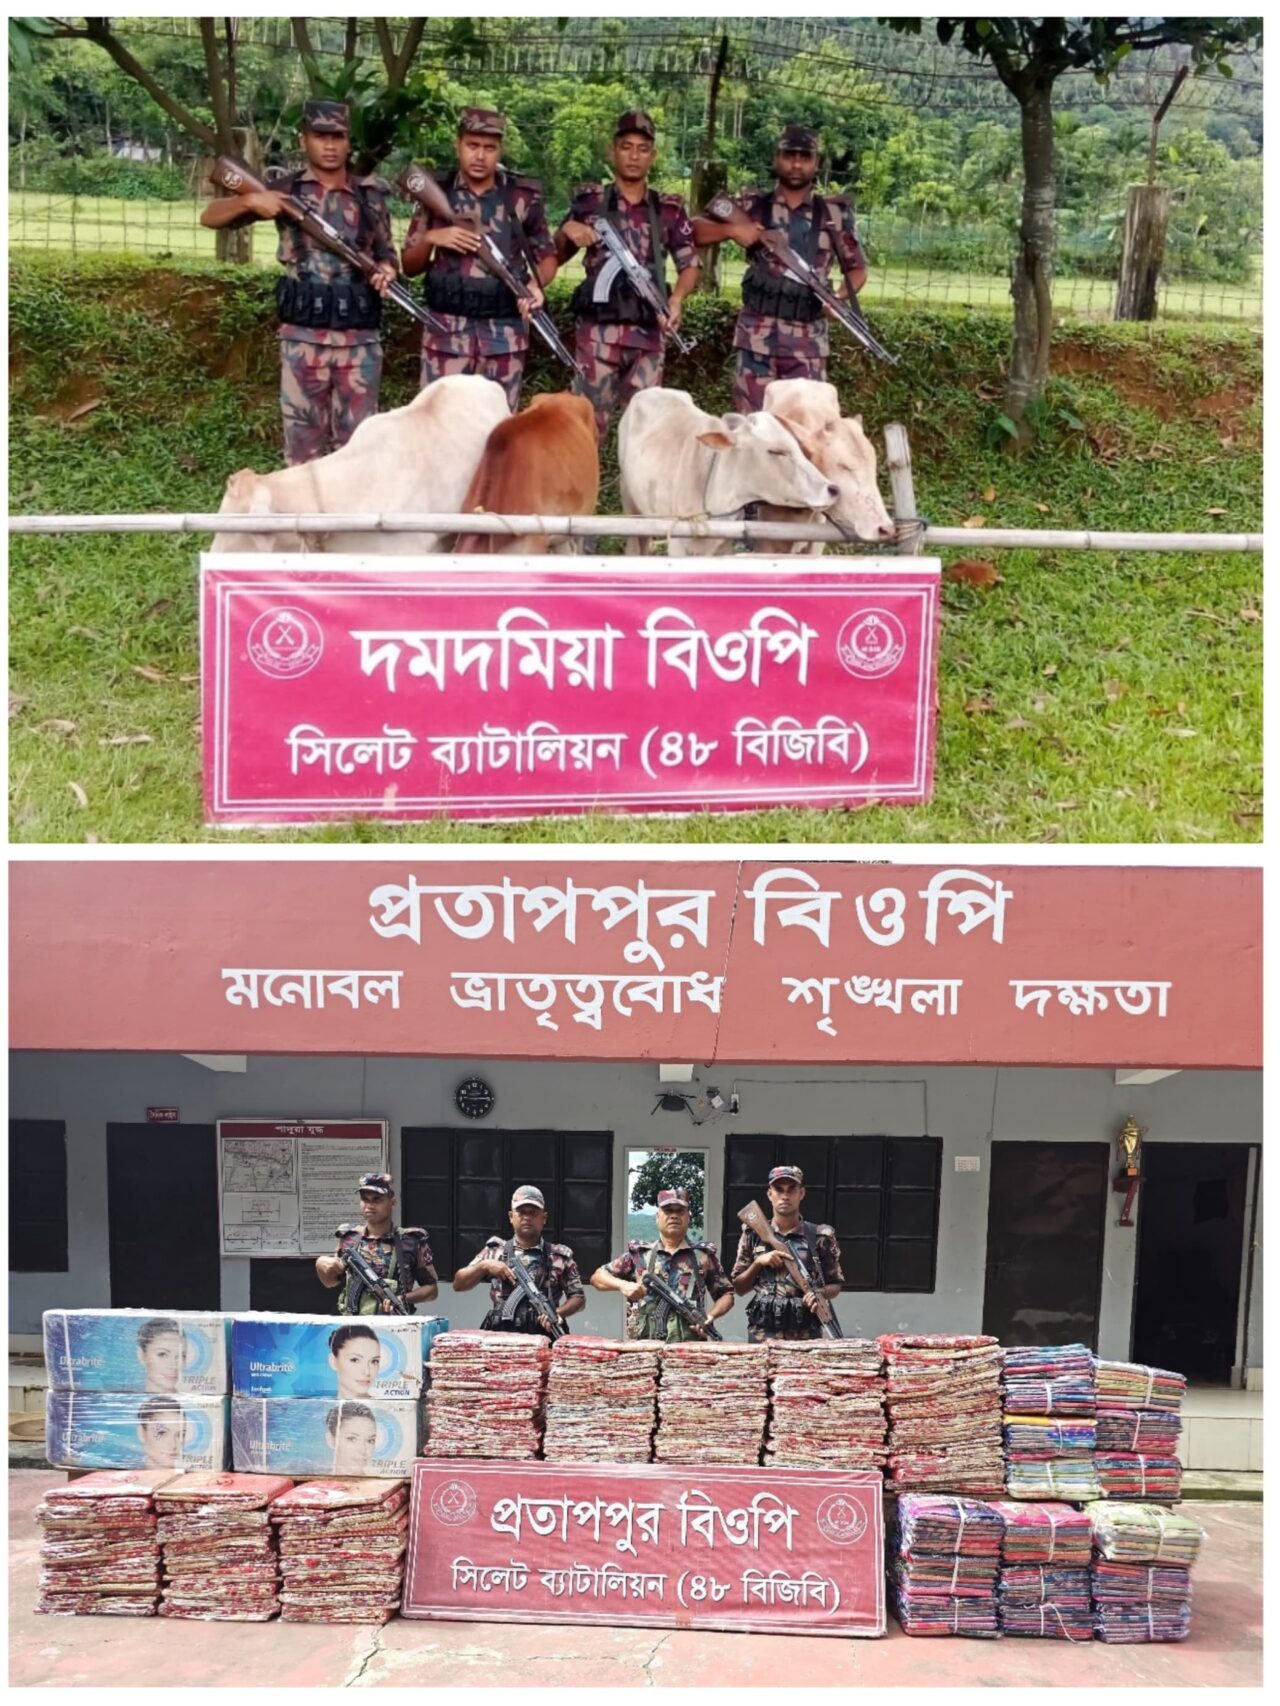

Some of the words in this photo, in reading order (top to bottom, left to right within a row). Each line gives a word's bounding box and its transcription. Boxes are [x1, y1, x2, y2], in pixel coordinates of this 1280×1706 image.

[348, 606, 625, 692] দমদমিয়া
[637, 606, 819, 690] বিওপি
[284, 722, 418, 776] সিলেট
[429, 721, 628, 774] ব্যাটালিয়ন
[639, 726, 718, 780] (৪৮
[731, 714, 870, 774] বিজিবি)
[369, 874, 716, 971] প্রতাপপুর
[221, 968, 404, 1010] মনোবল
[449, 970, 725, 1032] ভ্রাতৃত্ববোধ
[781, 974, 963, 1037] শৃঙ্খলা
[1008, 979, 1172, 1018] দক্ষতা
[183, 1375, 217, 1385] TRIPLE
[250, 1361, 294, 1373] Ultrabrite
[376, 1380, 410, 1390] TRIPLE
[383, 1388, 411, 1397] ACTION
[490, 1492, 664, 1557] প্রতাপপুর
[676, 1488, 800, 1551] বিওপি
[449, 1555, 531, 1592] সিলেট
[538, 1560, 668, 1600] ব্যাটালিয়ন
[676, 1569, 731, 1609] (৪৮
[740, 1570, 842, 1615] বিজিবি)
